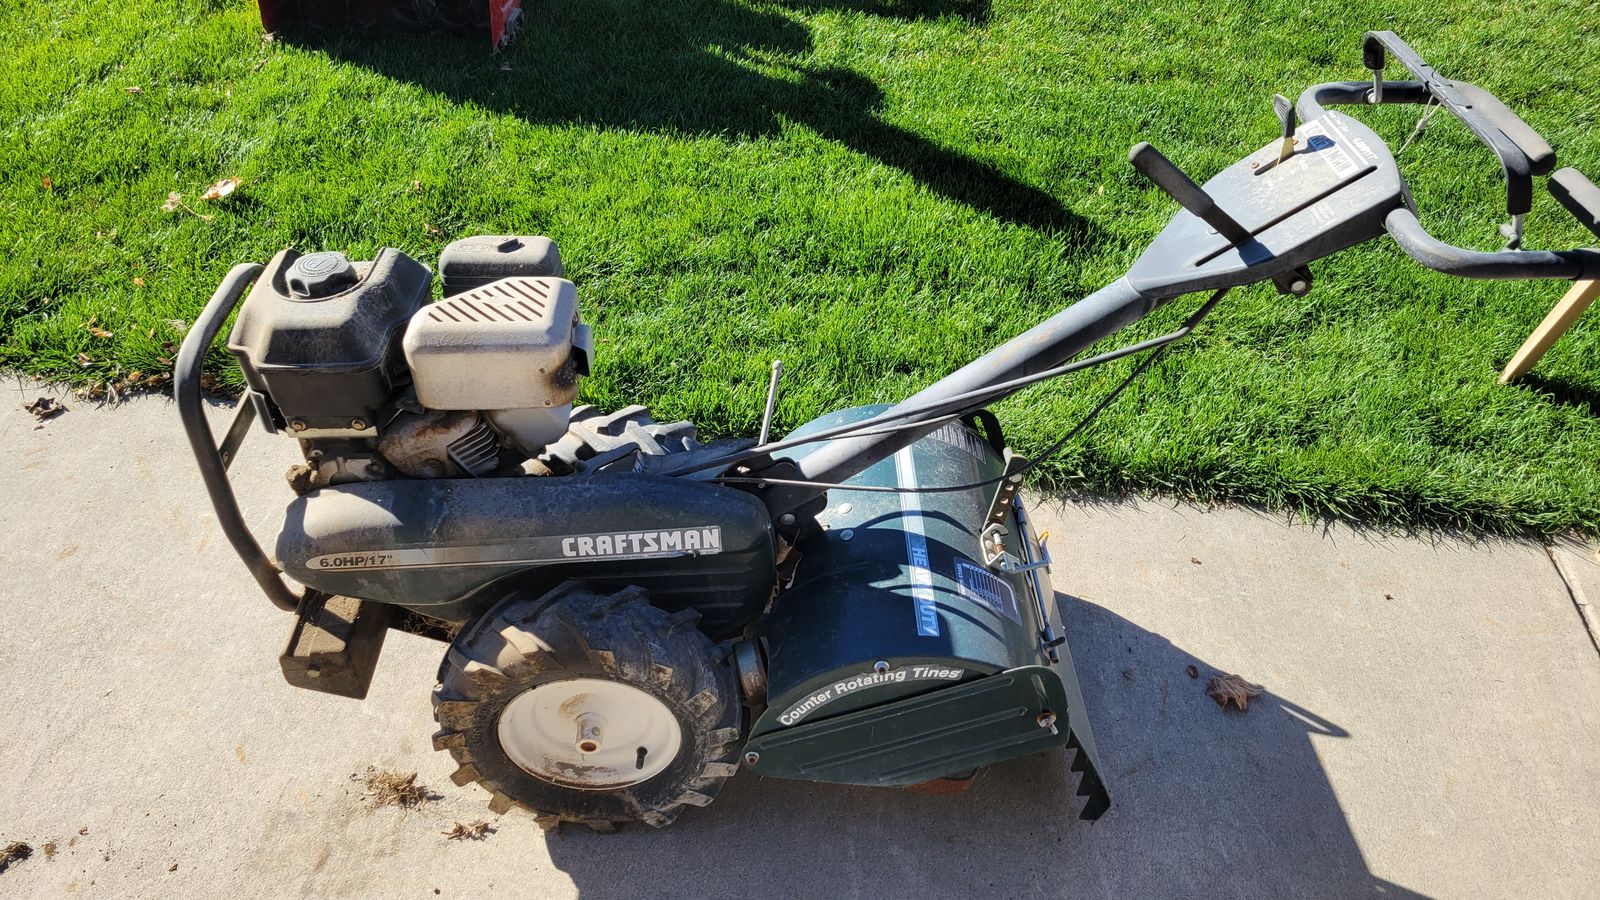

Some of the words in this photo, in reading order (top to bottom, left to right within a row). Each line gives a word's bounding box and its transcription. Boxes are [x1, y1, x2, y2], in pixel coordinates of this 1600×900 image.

[561, 528, 721, 557] CRAFTSMAN
[319, 553, 393, 569] 6.0HP/17"
[779, 688, 832, 726] Counter
[834, 670, 907, 695] Rotating
[912, 667, 961, 679] Tines
